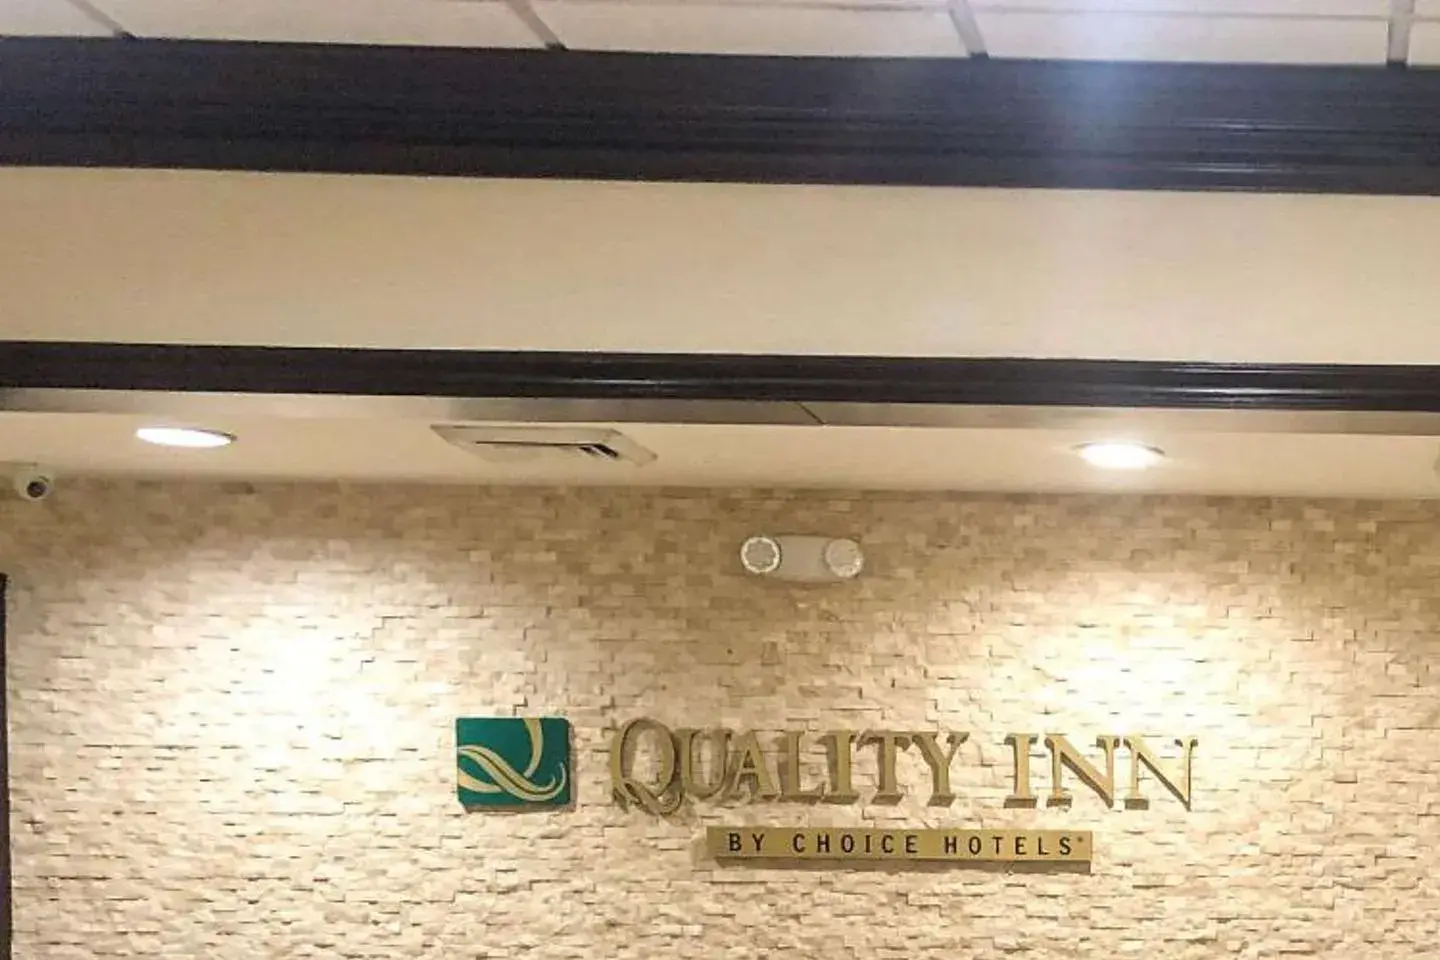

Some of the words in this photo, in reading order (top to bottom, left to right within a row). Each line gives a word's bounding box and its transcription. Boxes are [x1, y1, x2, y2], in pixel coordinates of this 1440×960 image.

[611, 718, 969, 815] QUALITY
[1003, 732, 1198, 812] INN
[728, 833, 765, 852] BY
[792, 834, 918, 854] CHOICE
[943, 836, 1072, 856] HOTELS
